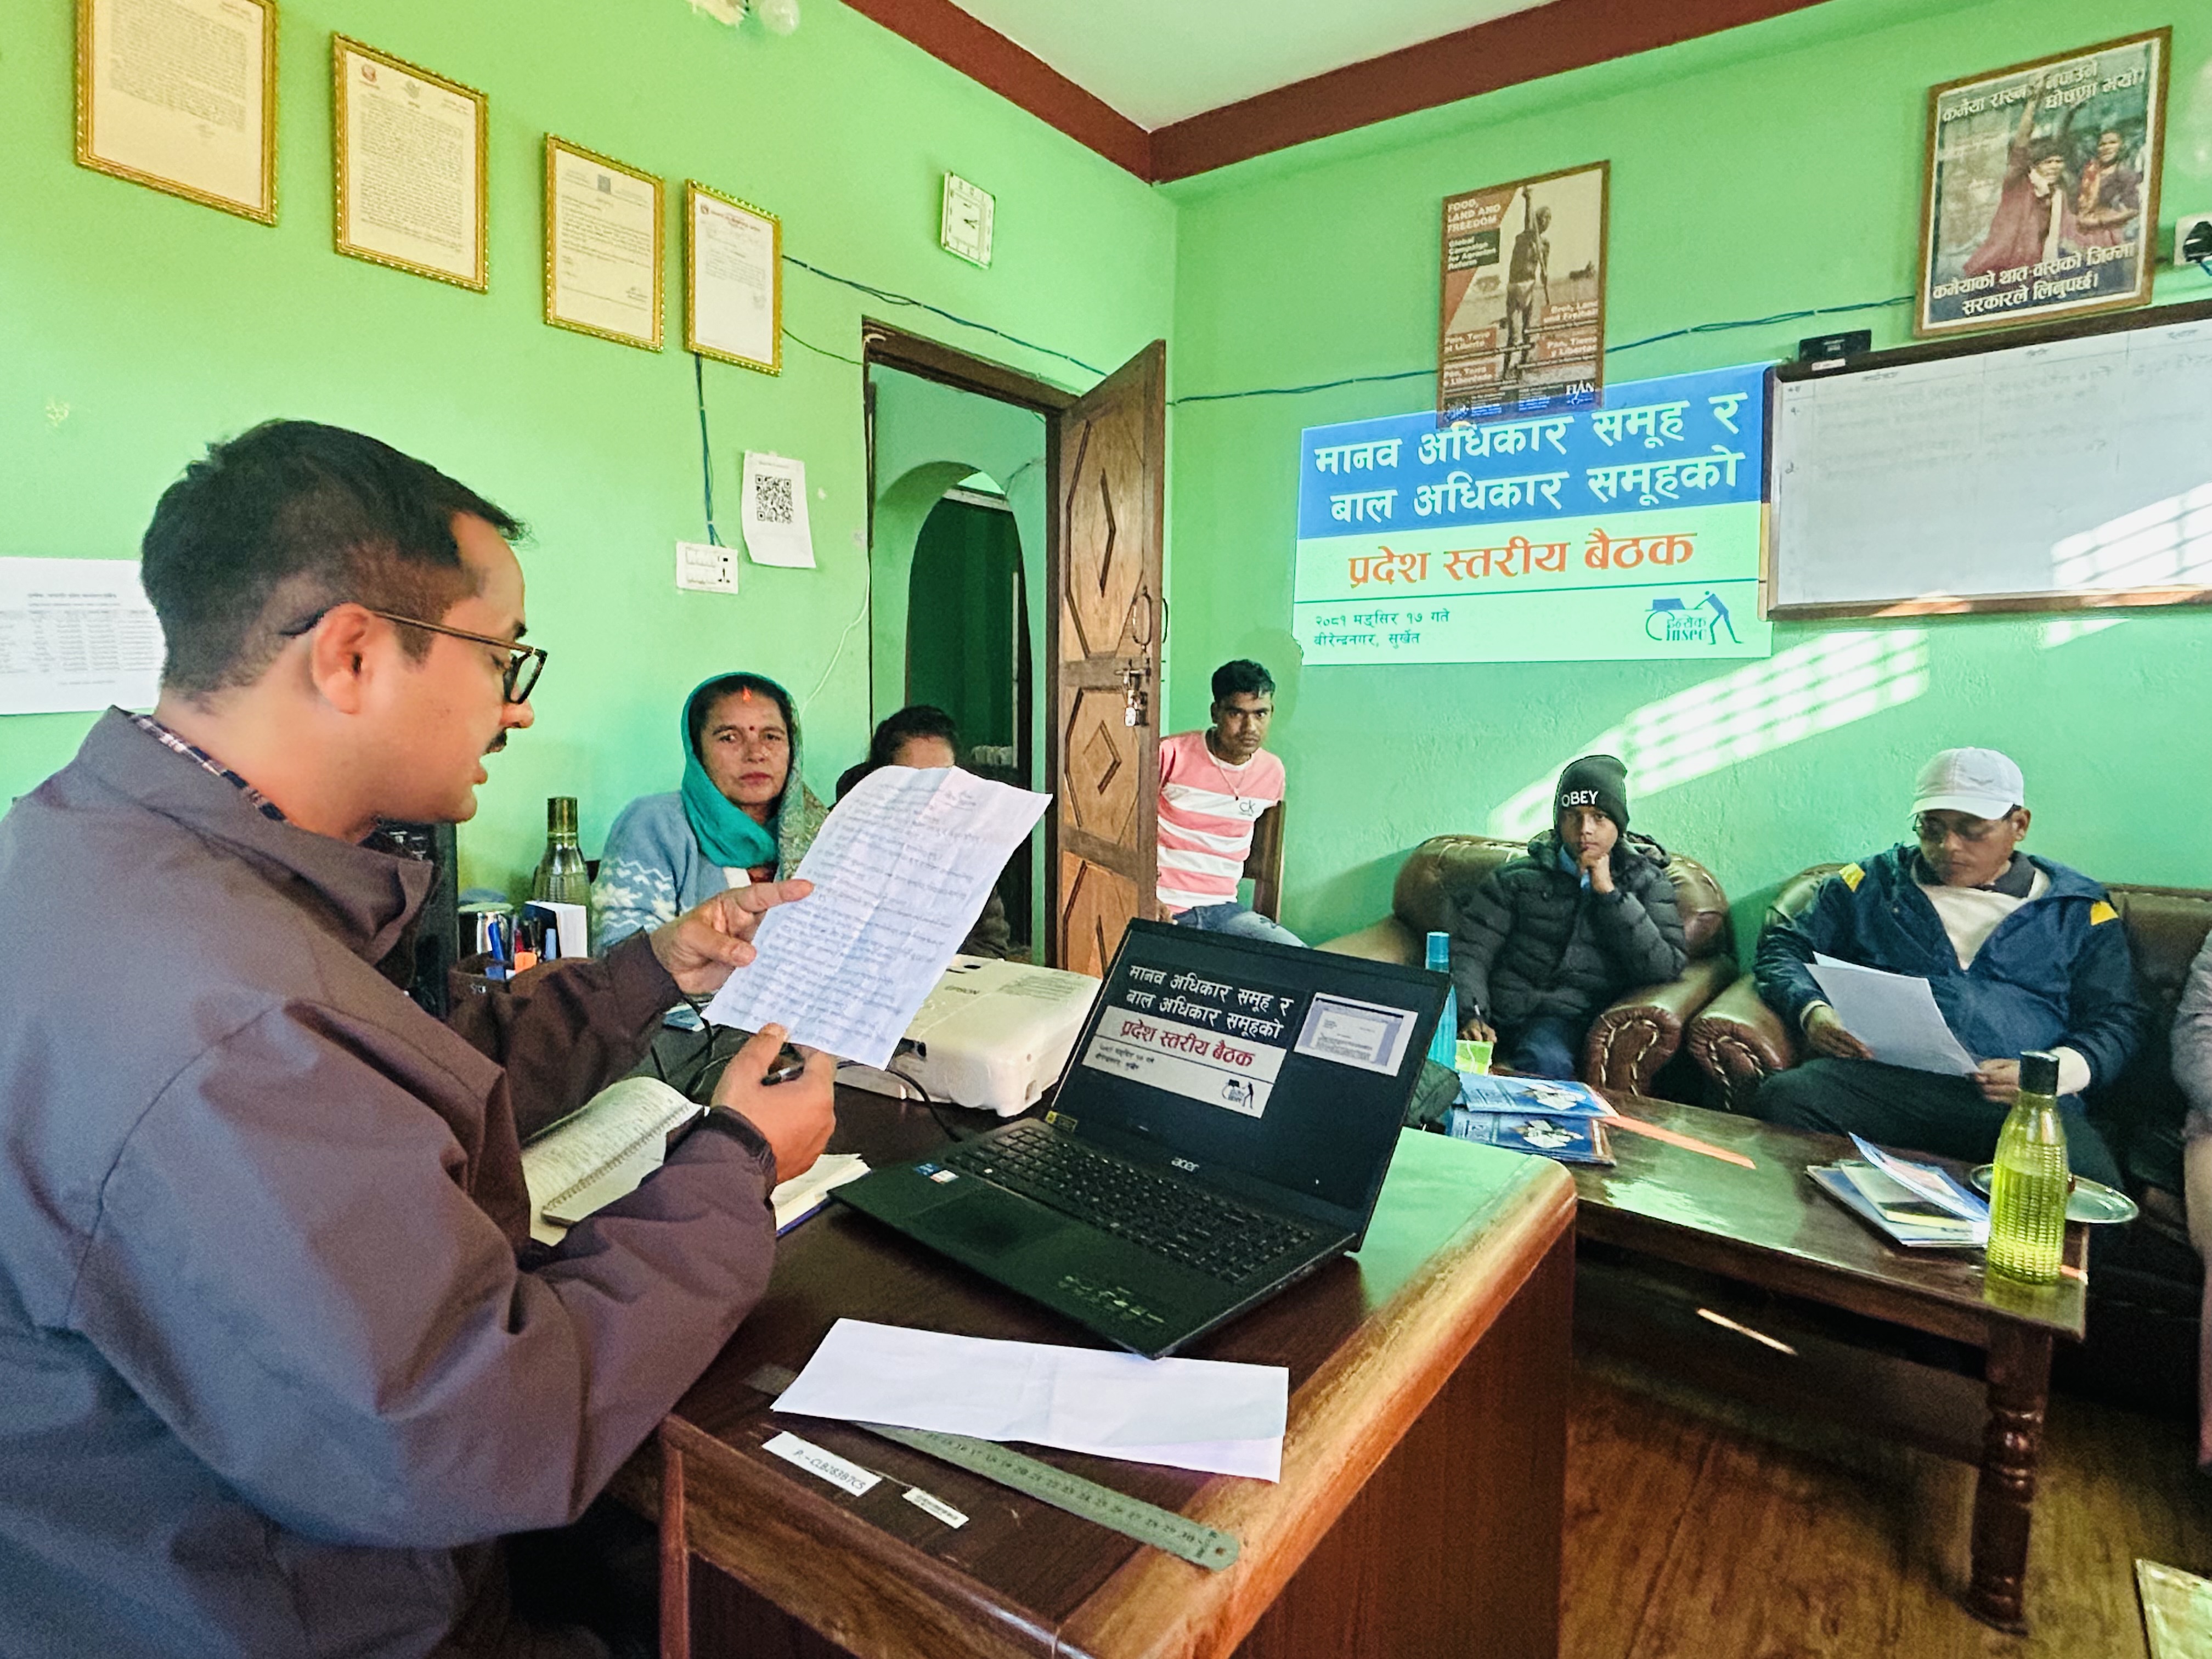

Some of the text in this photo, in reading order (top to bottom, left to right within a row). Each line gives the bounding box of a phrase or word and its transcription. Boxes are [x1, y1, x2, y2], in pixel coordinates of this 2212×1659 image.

[1961, 285, 2029, 316] सरकारले
[1314, 392, 1748, 475] मानव अधिकार समूह र
[1330, 444, 1746, 523] बाल अधिकार समूहको
[1348, 527, 1698, 589] प्रदेश स्तरीय बैठक
[1315, 614, 1346, 627] २०८१
[1406, 612, 1423, 624] १७
[1431, 608, 1450, 623] गते
[1561, 790, 1599, 808] OBEY
[1126, 989, 1285, 1039] बाल अधिकार समूहको
[1129, 964, 1295, 1016] मानव अधिकार समूह र
[1120, 1018, 1158, 1042] प्रदेश
[1160, 1030, 1211, 1056] स्तरीय
[1212, 1039, 1256, 1067] बैठक
[1171, 1156, 1200, 1172] acer
